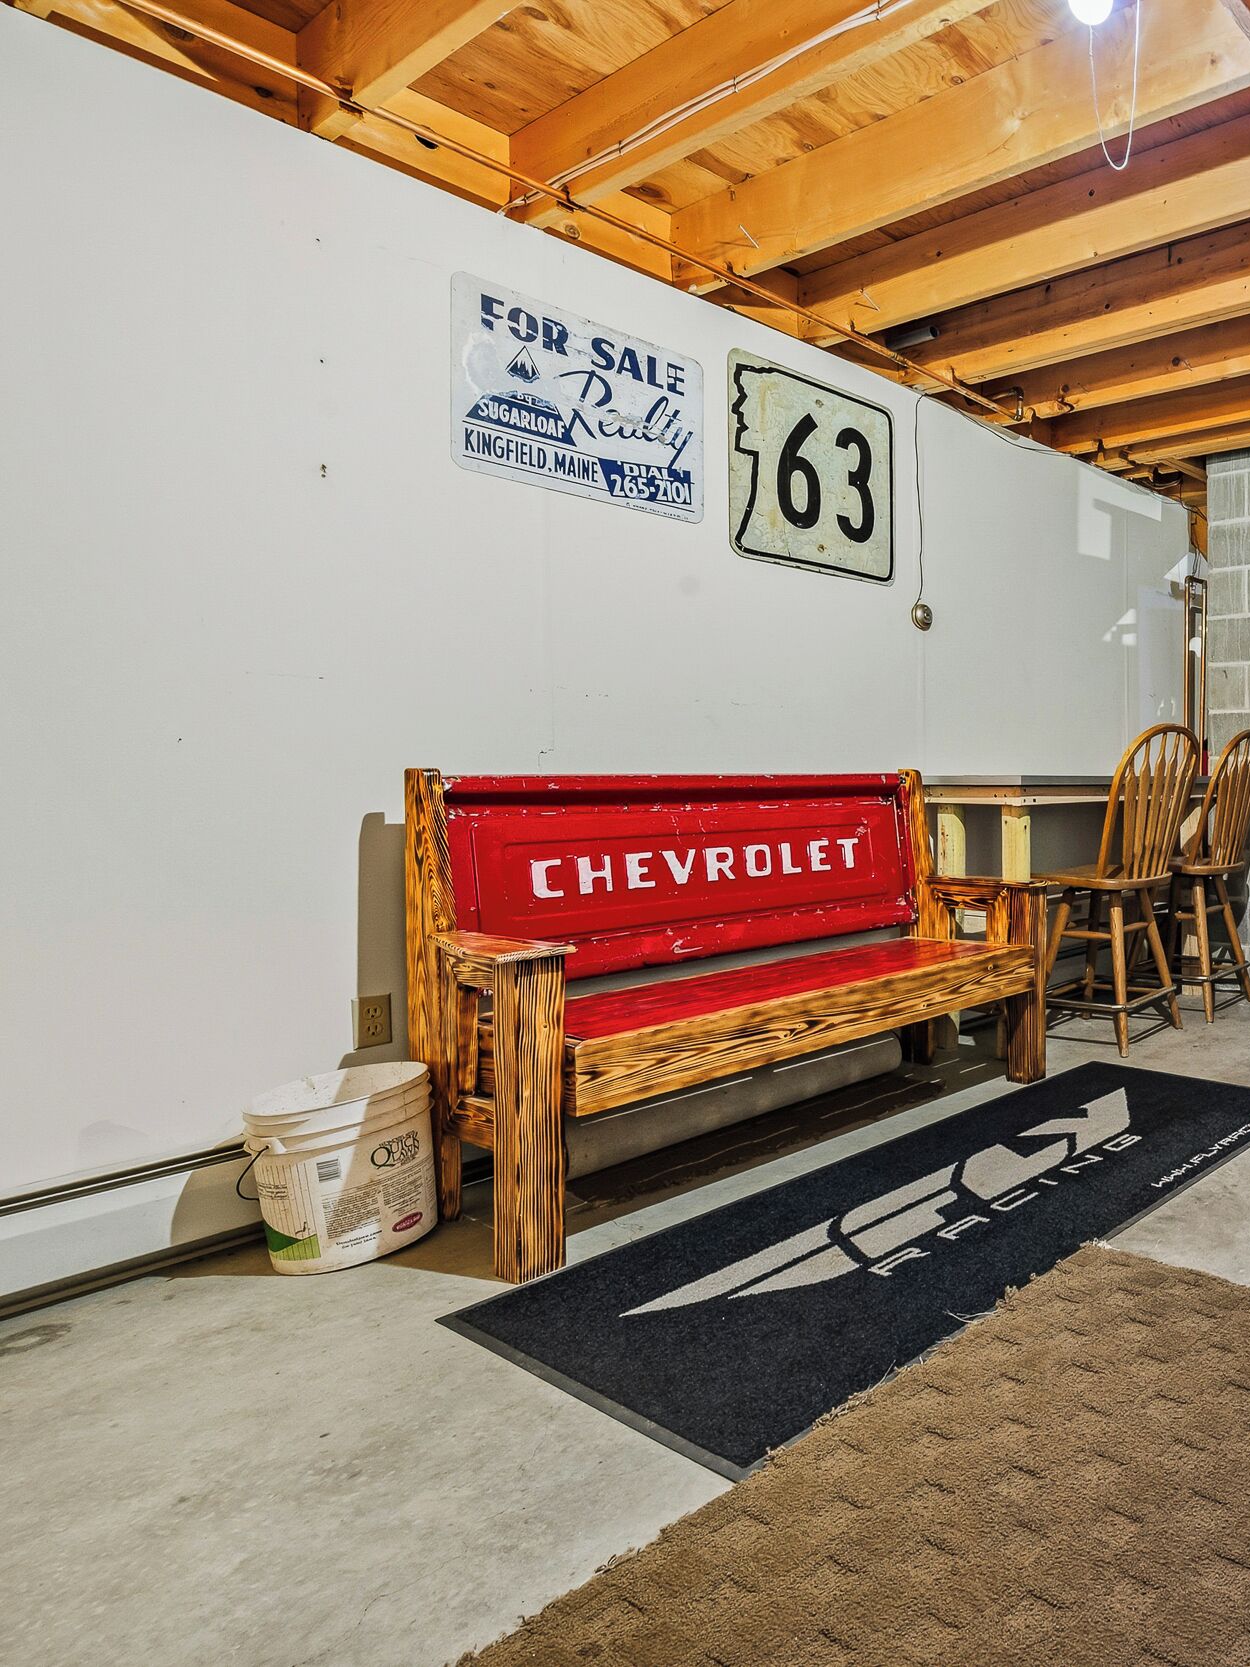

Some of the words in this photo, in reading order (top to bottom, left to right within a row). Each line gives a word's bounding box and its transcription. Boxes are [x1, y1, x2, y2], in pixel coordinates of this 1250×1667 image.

[481, 292, 569, 357] FOR
[590, 336, 685, 397] SALE
[478, 398, 565, 439] SUGARLOAF
[553, 368, 694, 468] Realty
[464, 427, 552, 473] KINGFIELD,
[554, 450, 599, 484] MAINE
[623, 462, 675, 482] DIAL
[776, 412, 875, 544] 63
[610, 474, 692, 505] 265-2101
[531, 836, 859, 899] CHEVROLET
[868, 1134, 1143, 1276] RACING
